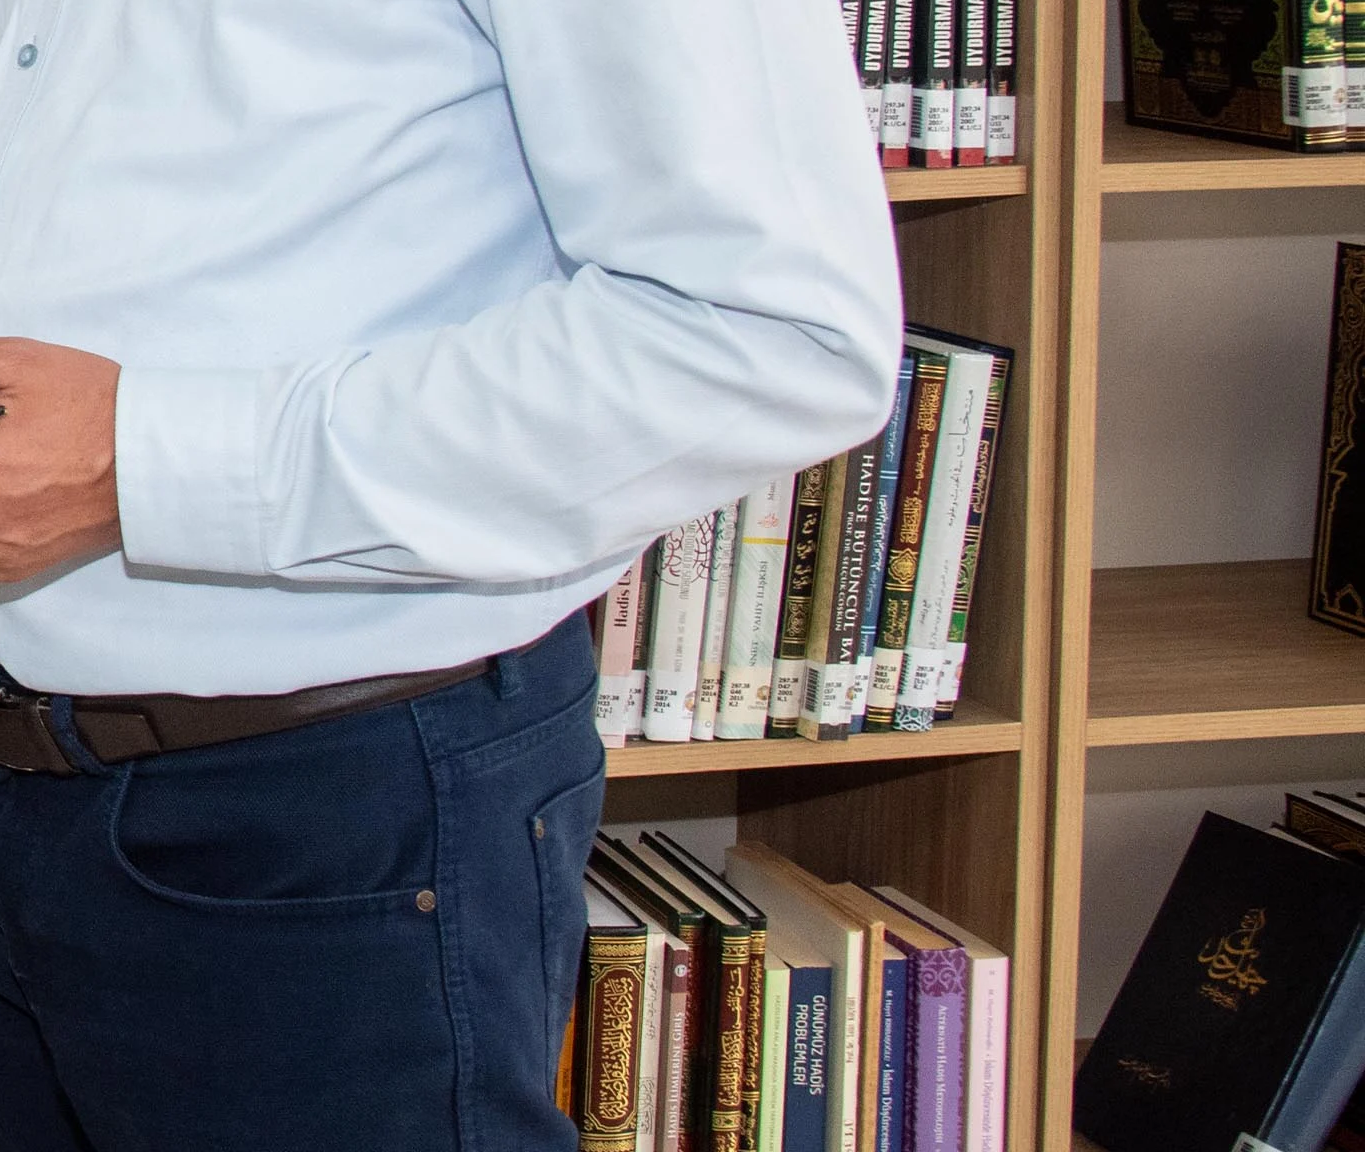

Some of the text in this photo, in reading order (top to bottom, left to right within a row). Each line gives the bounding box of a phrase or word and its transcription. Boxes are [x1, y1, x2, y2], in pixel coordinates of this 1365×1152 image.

[864, 0, 887, 71] UYDURMA
[614, 566, 632, 627] Hadis Us
[840, 555, 850, 590] SELÇUK
[844, 530, 866, 631] BÜTÜNCÜL
[752, 602, 763, 632] VAHİY
[836, 592, 846, 632] COŞKUN
[793, 1004, 809, 1086] PROBLEMLERİ
[810, 995, 827, 1056] GÜNÜMÜZ
[882, 1069, 894, 1095] İslam
